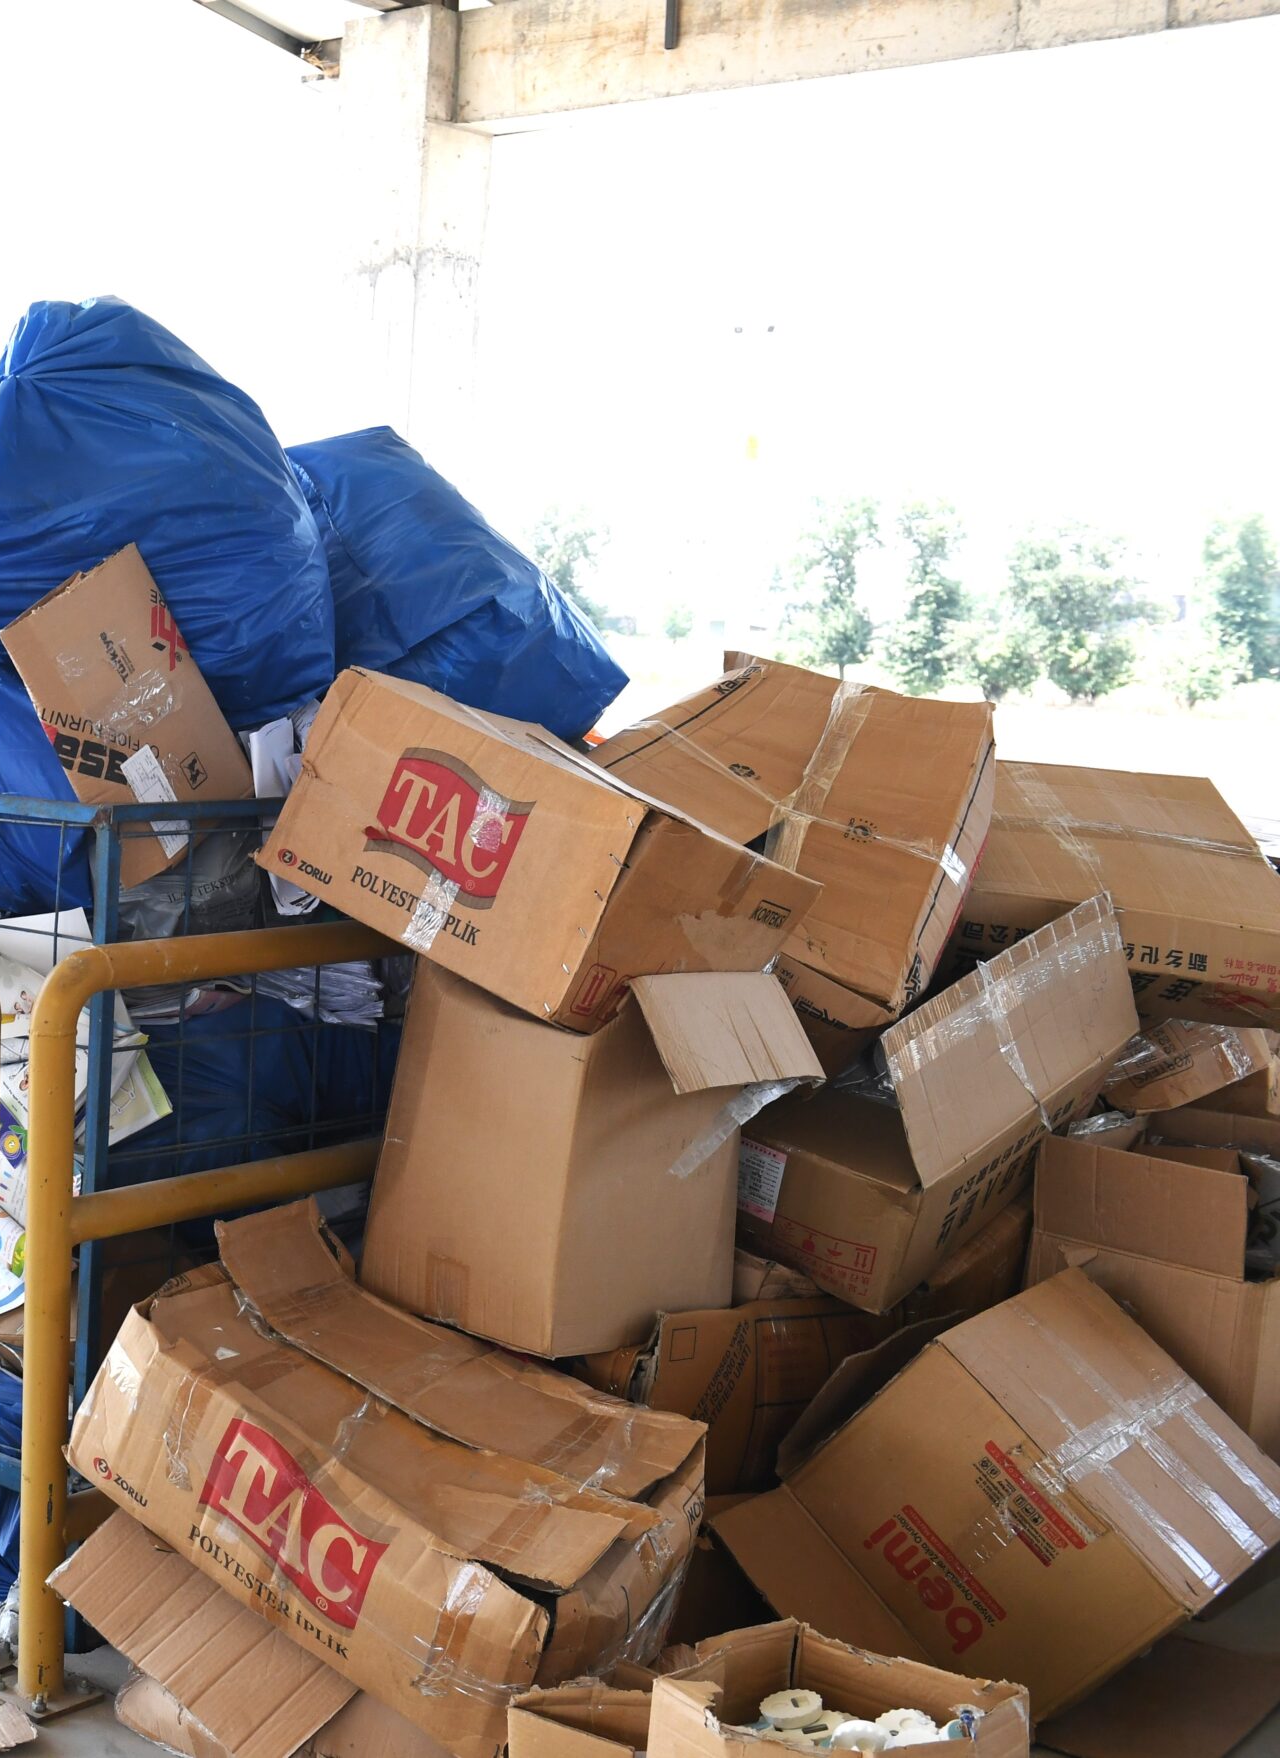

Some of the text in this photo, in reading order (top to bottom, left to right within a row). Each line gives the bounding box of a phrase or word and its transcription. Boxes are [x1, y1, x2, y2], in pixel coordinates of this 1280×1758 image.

[388, 769, 515, 879] TAC
[297, 859, 333, 886] ZORLU
[440, 910, 481, 946] PLİK
[710, 1380, 724, 1406] ISO
[113, 1474, 148, 1508] ZORLU
[219, 1433, 368, 1602] TAC
[187, 1524, 349, 1660] POLYESTER İPLİK
[863, 1518, 983, 1655] bemi
